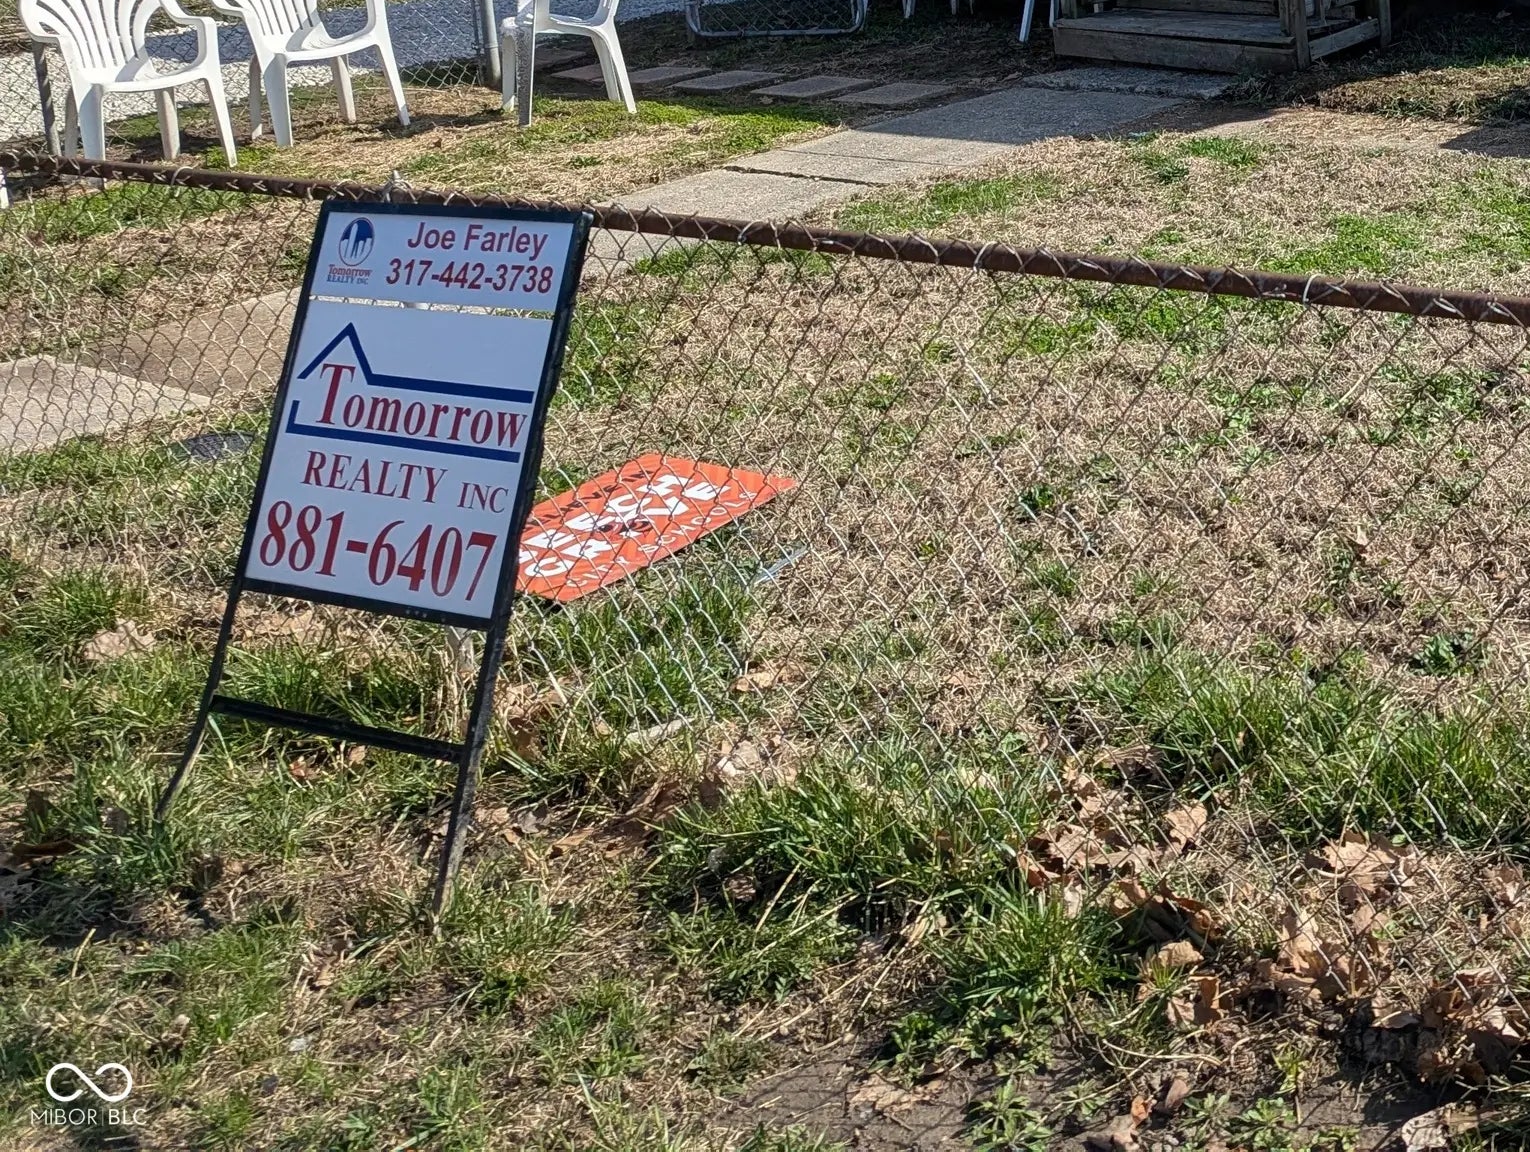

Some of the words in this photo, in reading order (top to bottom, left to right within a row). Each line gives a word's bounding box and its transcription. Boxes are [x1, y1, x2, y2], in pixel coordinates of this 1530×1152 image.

[408, 222, 456, 250] Joe
[463, 224, 549, 261] Farley
[326, 274, 355, 285] REALTY
[328, 264, 373, 277] Tomorrow
[386, 258, 554, 294] 317-442-3738
[316, 363, 528, 448] Tomorrow
[302, 450, 448, 504] REALTY
[457, 482, 510, 515] INC
[524, 485, 622, 533] ELIEVE
[637, 491, 758, 554] SCHOOLS
[259, 500, 498, 602] 881-6407
